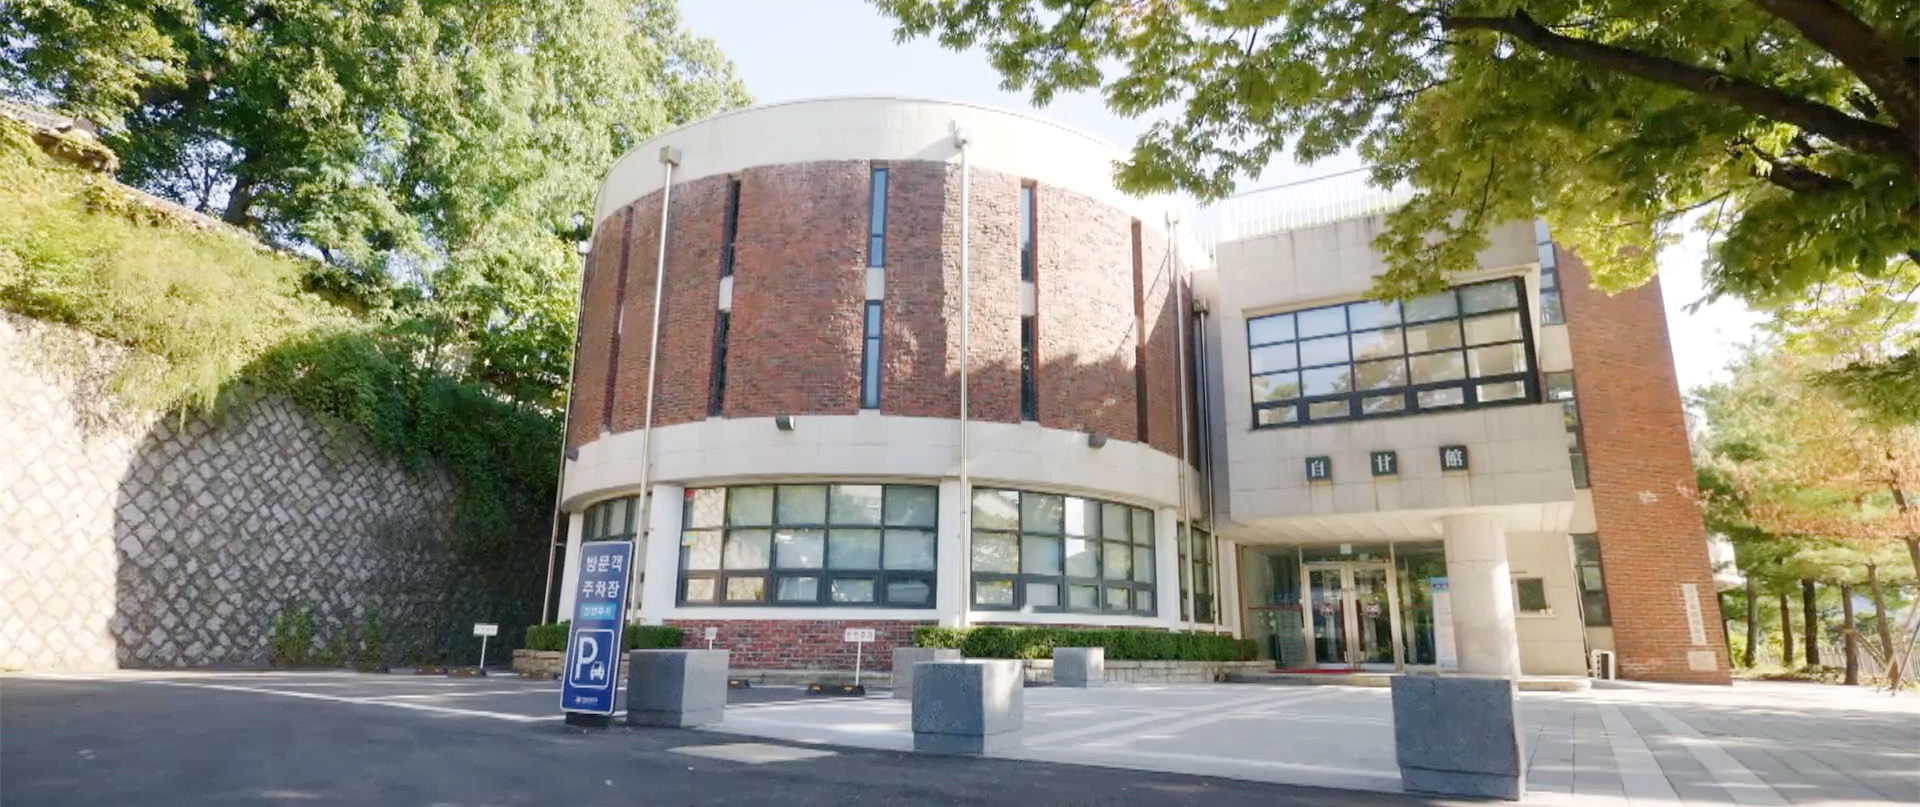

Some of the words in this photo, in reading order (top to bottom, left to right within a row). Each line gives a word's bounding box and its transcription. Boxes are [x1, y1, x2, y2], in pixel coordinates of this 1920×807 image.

[586, 554, 623, 572] 방문객
[582, 580, 620, 598] 주차장
[574, 636, 598, 681] P
